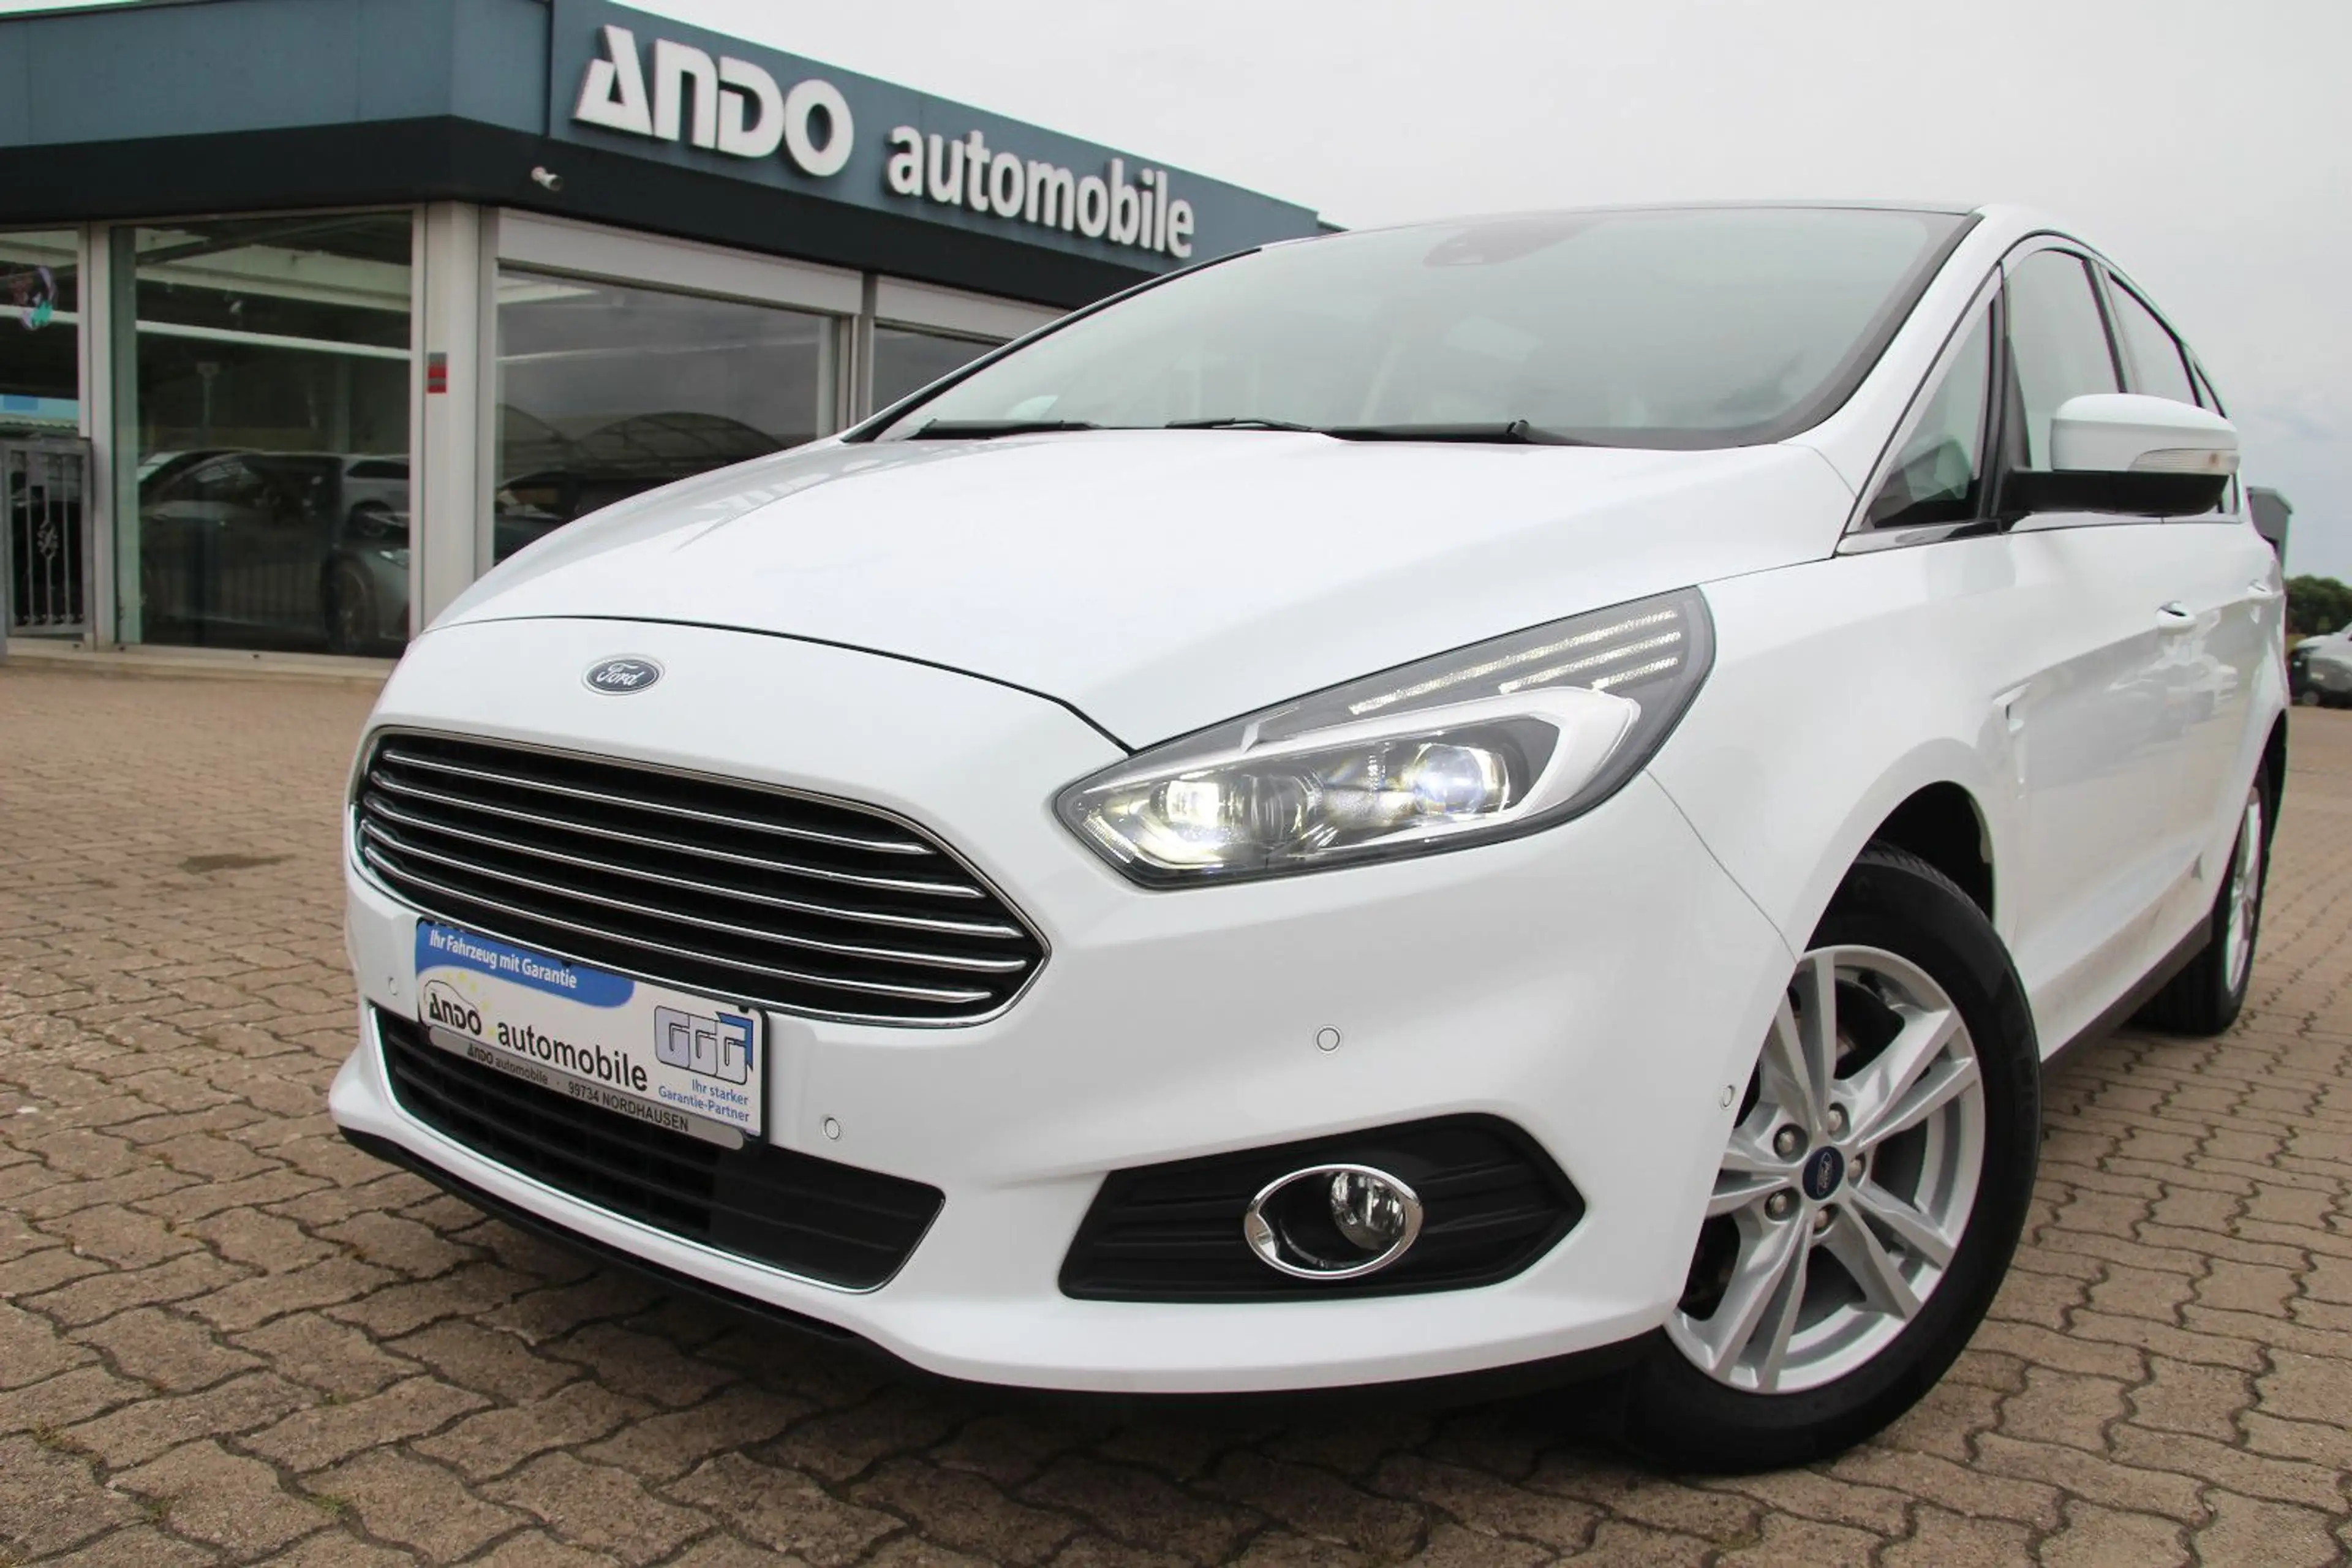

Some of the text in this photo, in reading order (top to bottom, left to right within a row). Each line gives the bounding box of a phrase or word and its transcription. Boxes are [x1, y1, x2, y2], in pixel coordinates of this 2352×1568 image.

[574, 24, 1194, 258] ANDO automobile
[596, 662, 645, 686] Ford
[430, 929, 578, 989] Ihr Fahrzeug mit Garantie
[495, 1057, 549, 1086] automobile
[497, 1022, 648, 1092] automobile
[568, 1080, 689, 1132] 99734 NORDHAUSEN
[658, 1085, 750, 1123] Garantie-Partner
[692, 1078, 748, 1106] Ihr starker
